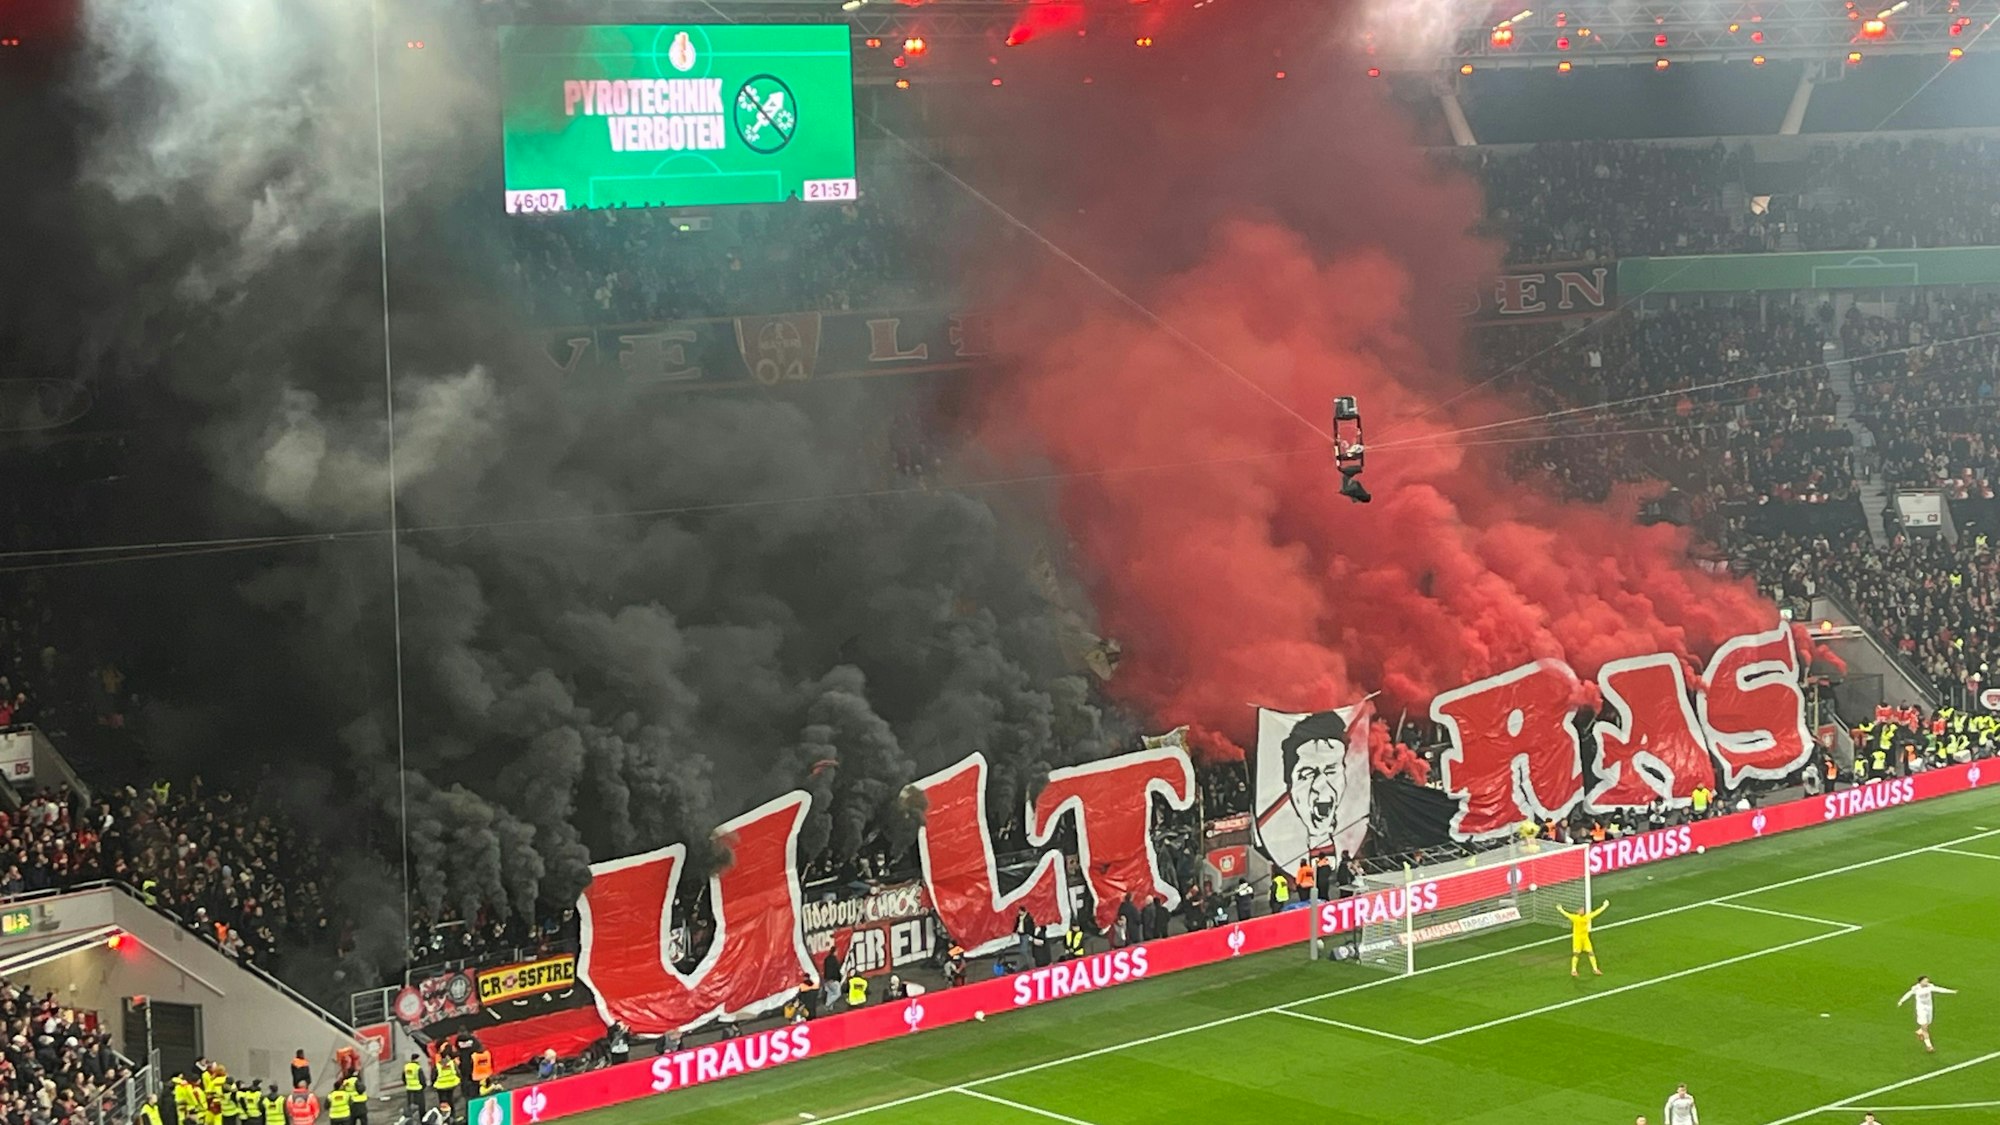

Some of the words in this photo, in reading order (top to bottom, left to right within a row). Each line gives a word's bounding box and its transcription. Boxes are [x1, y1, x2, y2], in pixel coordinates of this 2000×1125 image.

[564, 78, 724, 116] PYROTECHNIK
[609, 115, 726, 152] VERBOTEN
[514, 193, 560, 210] 46:07
[810, 183, 850, 198] 21:57
[756, 357, 808, 386] 04
[1824, 779, 1914, 820] STRAUSS
[1590, 827, 1692, 872] STRAUSS
[1322, 883, 1438, 933] STRAUSS
[1014, 947, 1148, 1005] STRAUSS
[652, 1025, 810, 1091] STRAUSS
